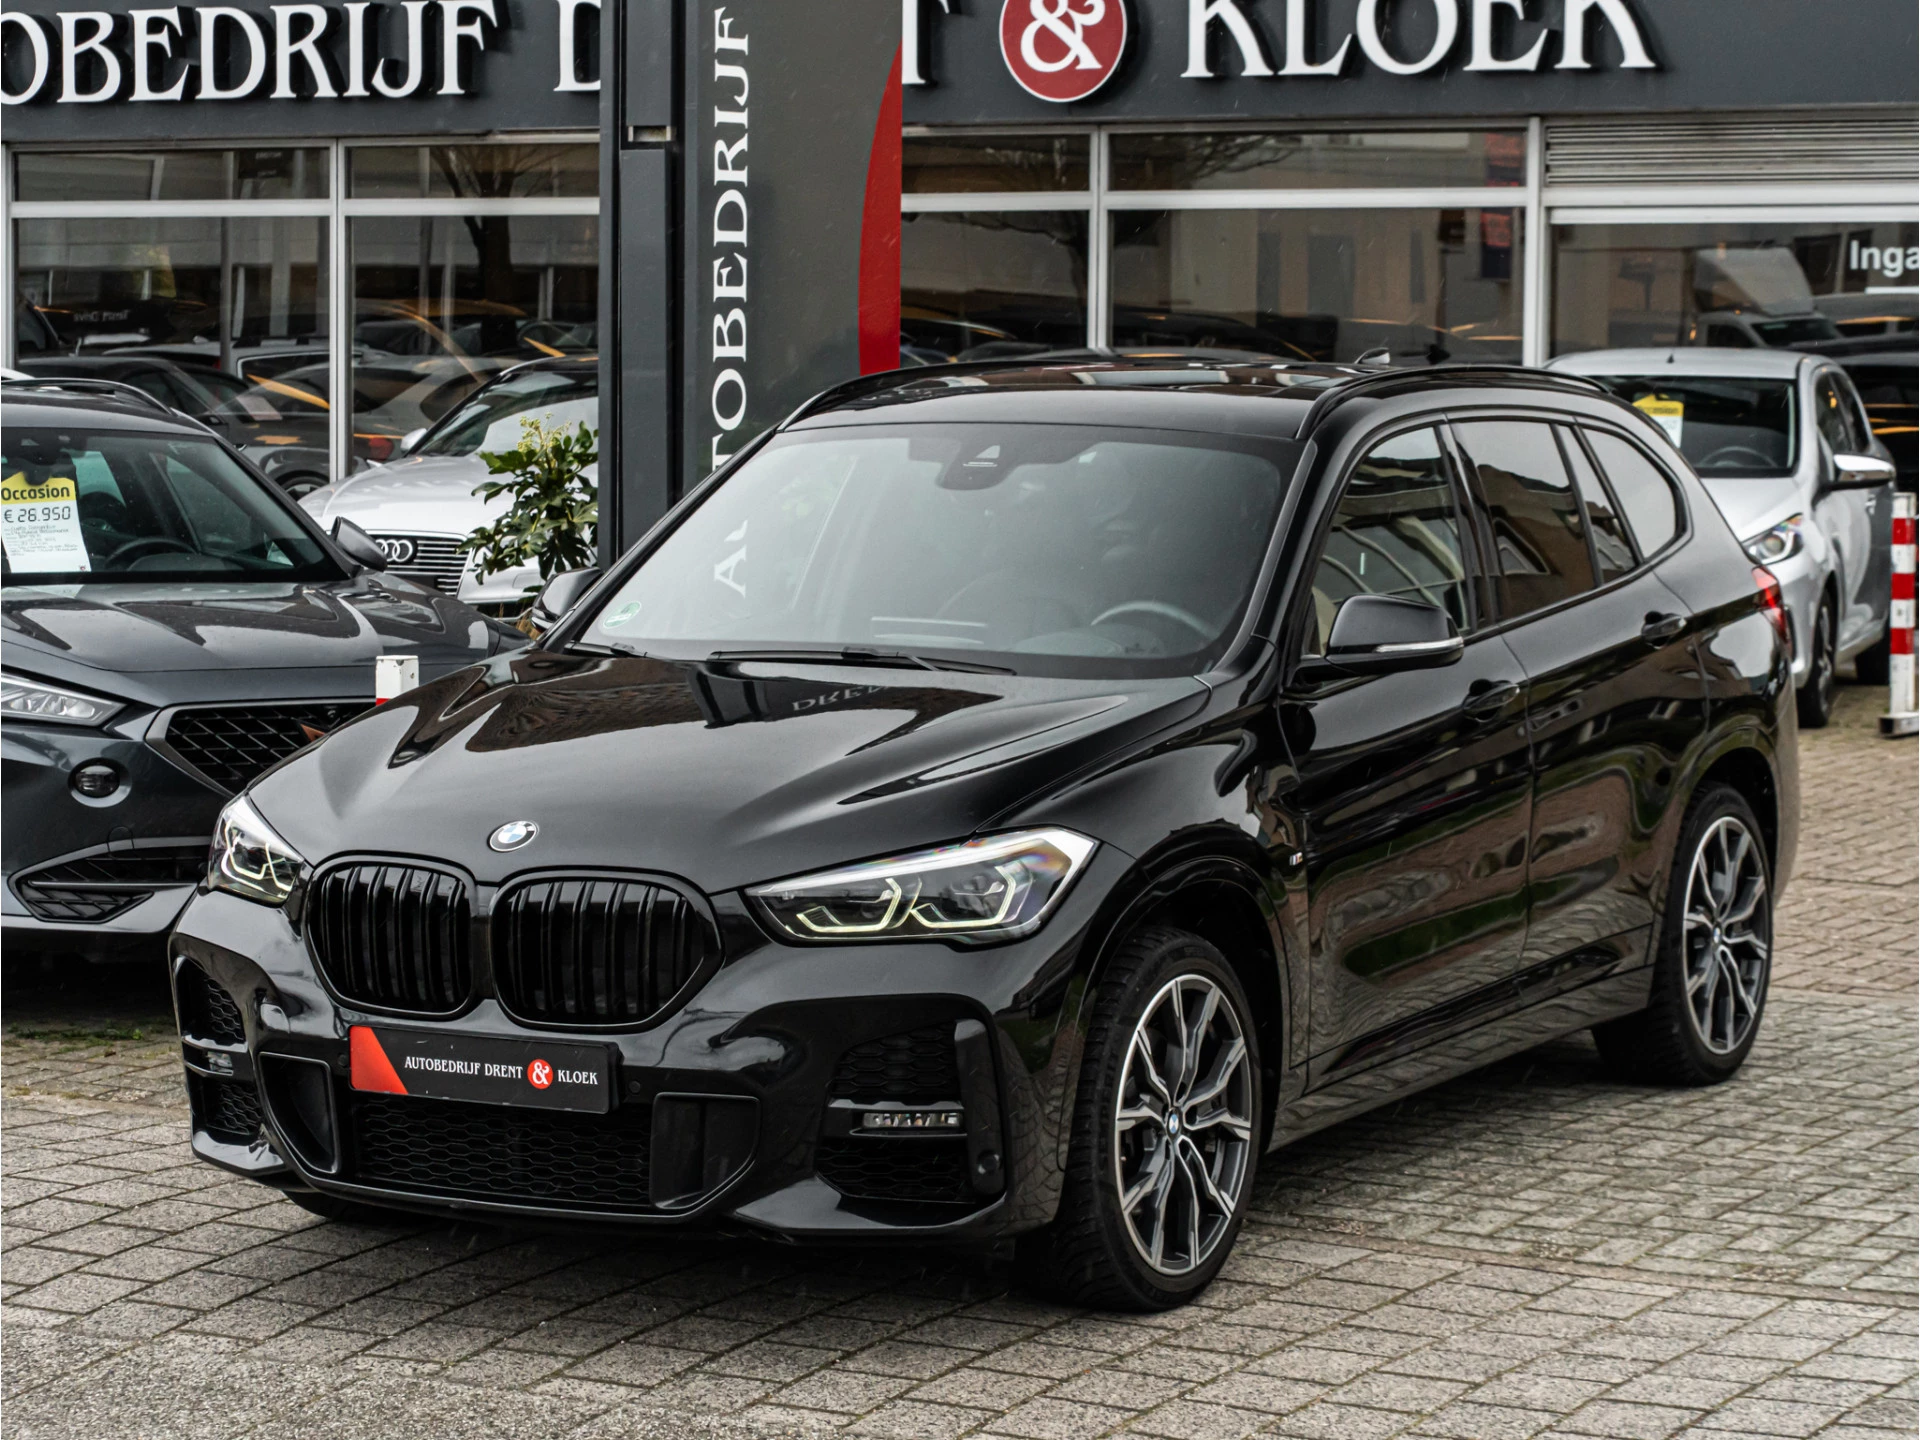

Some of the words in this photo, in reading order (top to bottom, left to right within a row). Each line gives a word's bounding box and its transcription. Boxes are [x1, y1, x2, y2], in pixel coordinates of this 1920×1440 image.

[1020, 0, 1106, 73] &
[1181, 0, 1656, 77] KLOEK
[1850, 240, 1919, 278] Inga
[1, 484, 70, 501] Occasion
[404, 1056, 481, 1075] AUTOBEDRIJF
[484, 1063, 523, 1079] DRENT
[531, 1062, 550, 1085] &
[557, 1069, 599, 1085] KLOEK
